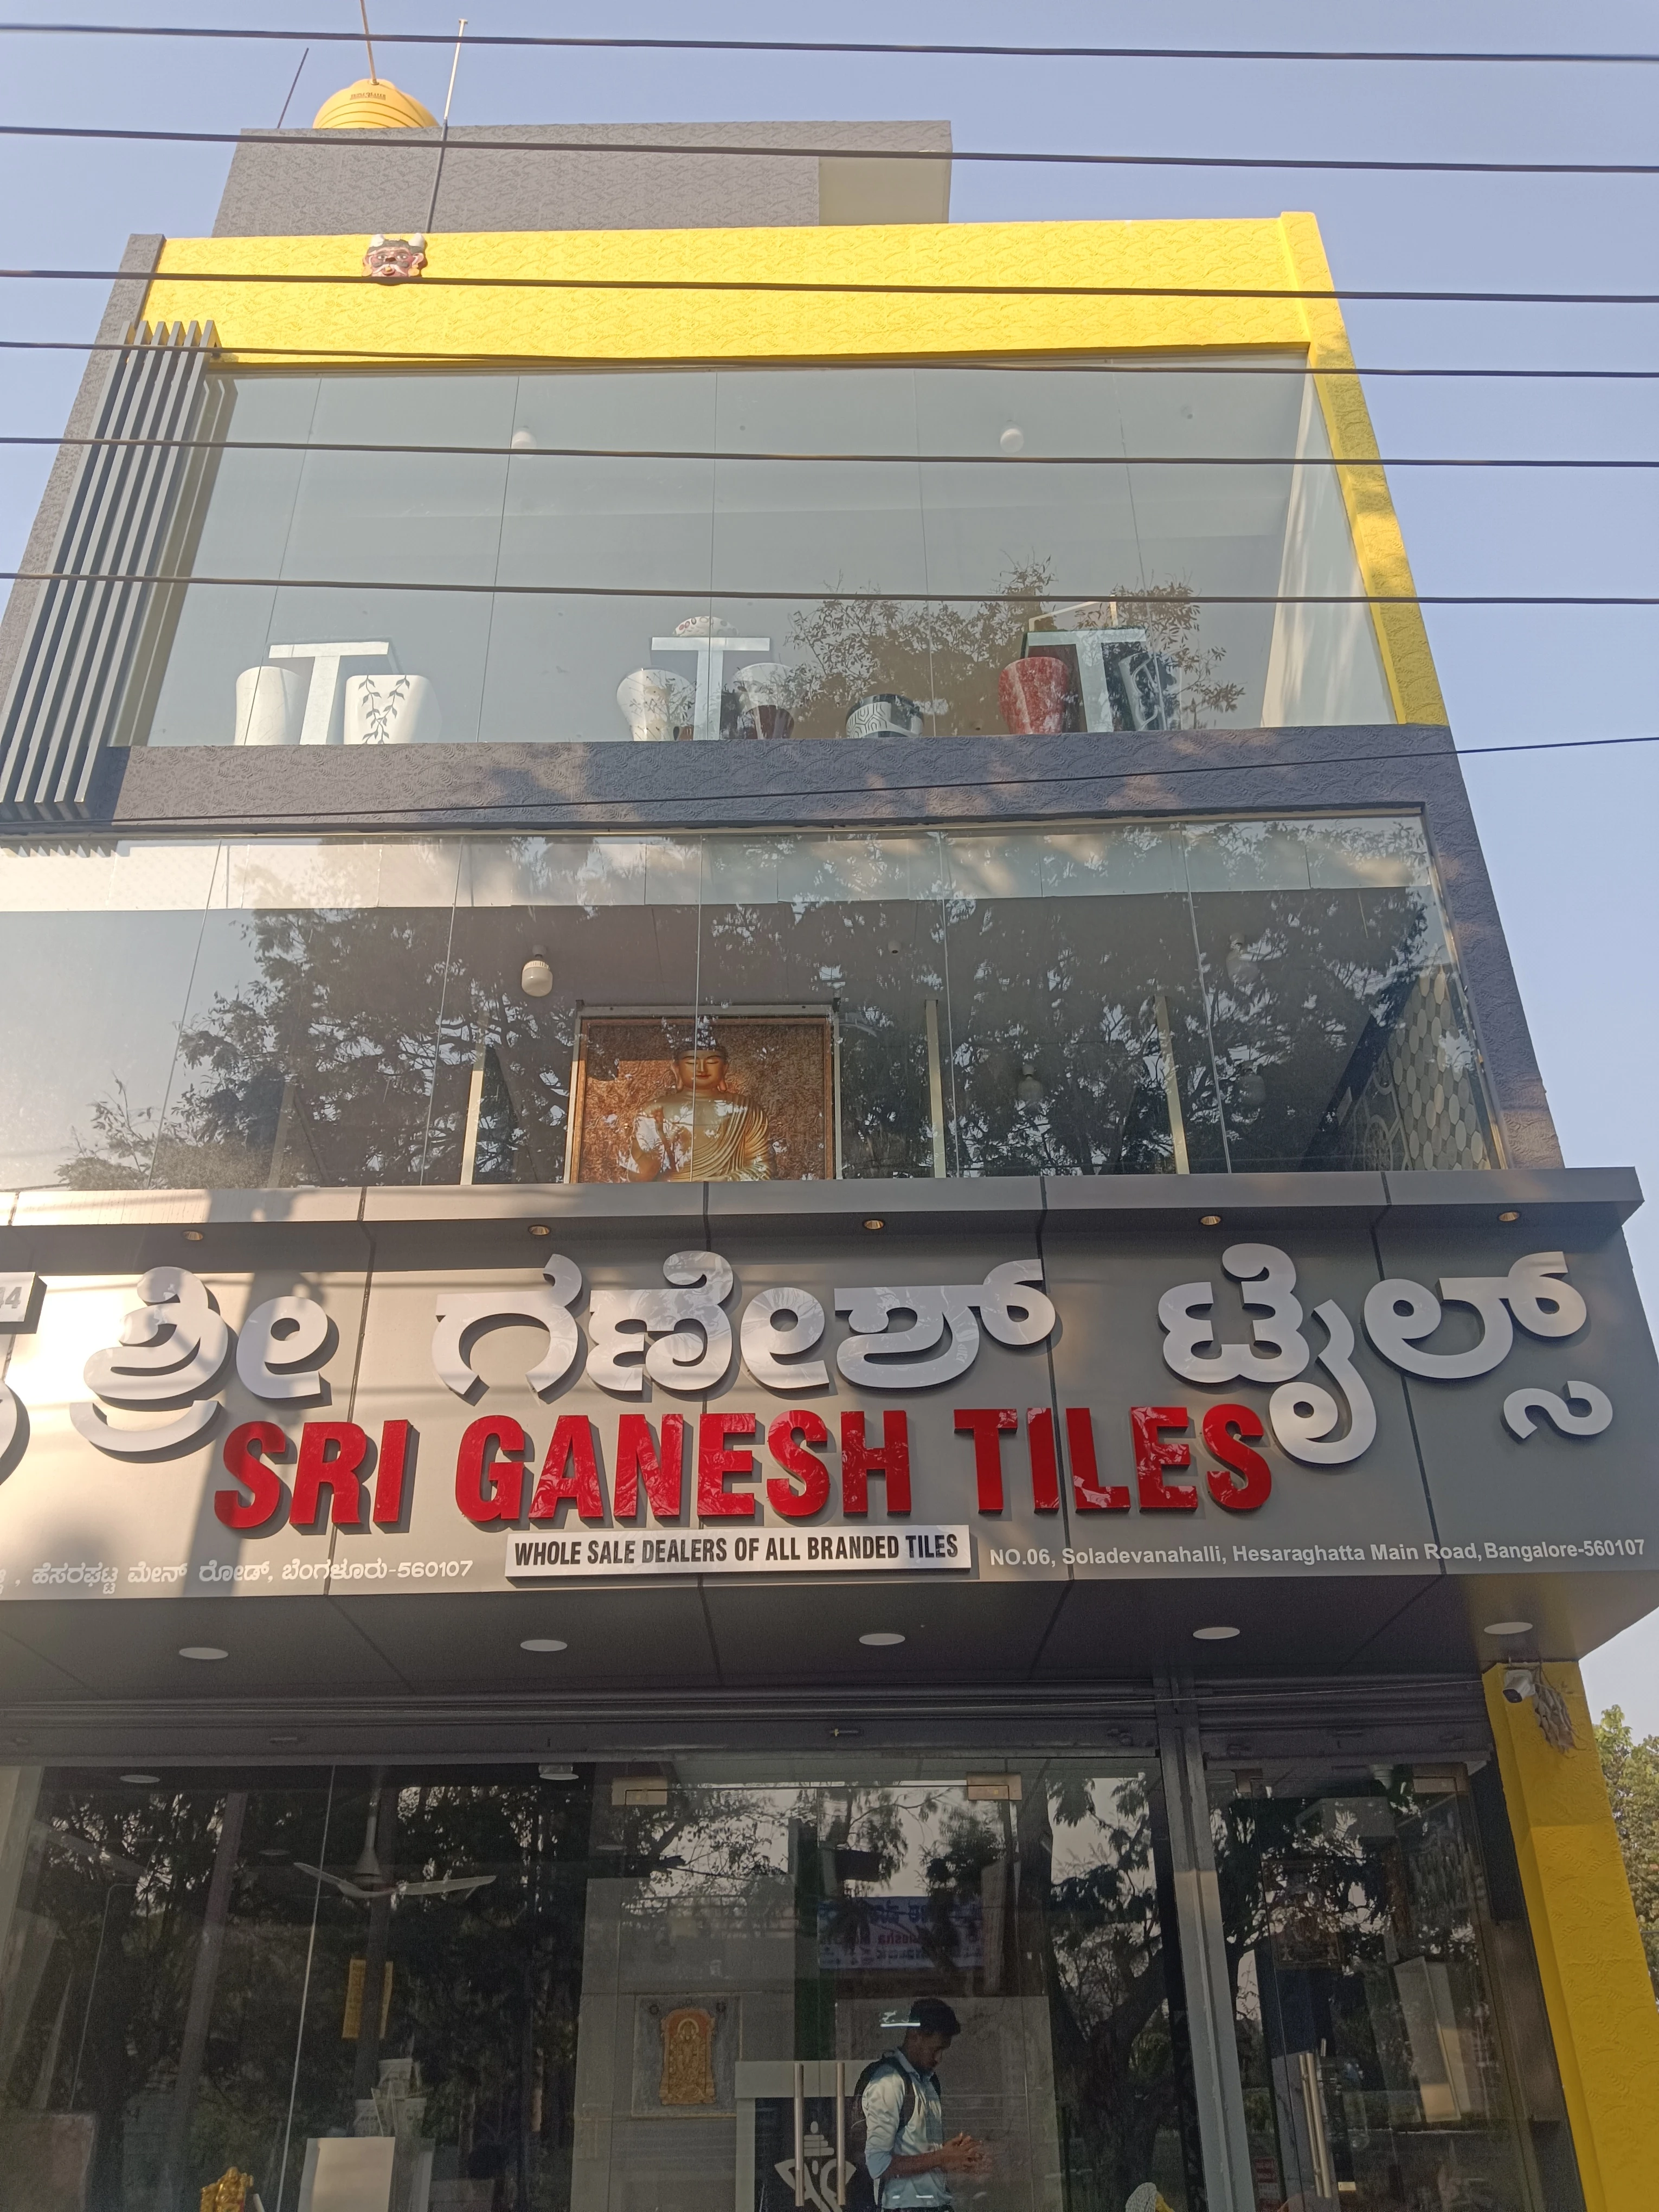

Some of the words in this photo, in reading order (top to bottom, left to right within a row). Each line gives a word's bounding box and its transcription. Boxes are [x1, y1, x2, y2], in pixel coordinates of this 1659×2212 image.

[69, 1265, 330, 1454] ಶ್ರೀ
[432, 1250, 1056, 1395] ಗಣೇಶ್
[1158, 1242, 1613, 1465] ಟೈಲ್ಸ್
[215, 1419, 409, 1530] SRI
[454, 1410, 911, 1521] GANESH
[954, 1403, 1272, 1512] TILES
[515, 1540, 582, 1566] WHOLE
[587, 1539, 635, 1564] SALE
[641, 1537, 728, 1563] DEALERS
[734, 1536, 760, 1560] OF
[765, 1535, 801, 1560] ALL
[807, 1534, 899, 1560] BRANDED
[904, 1533, 959, 1558] TILES
[990, 1548, 1056, 1568] NO.06,
[1062, 1545, 1227, 1565] Soladevanahalli,
[1233, 1545, 1365, 1566] Hesaraghatta
[1370, 1543, 1419, 1561] Main
[1424, 1542, 1482, 1561] Road,
[1485, 1539, 1645, 1562] Bangalore-560107
[31, 1561, 119, 1594] ಹೆಸರಘಟ್ಟ
[127, 1561, 188, 1583] ಮೇನ್
[198, 1559, 273, 1583] ರೋಡ್,
[281, 1557, 473, 1580] ಬೆಂಗಳೂರು-560107
